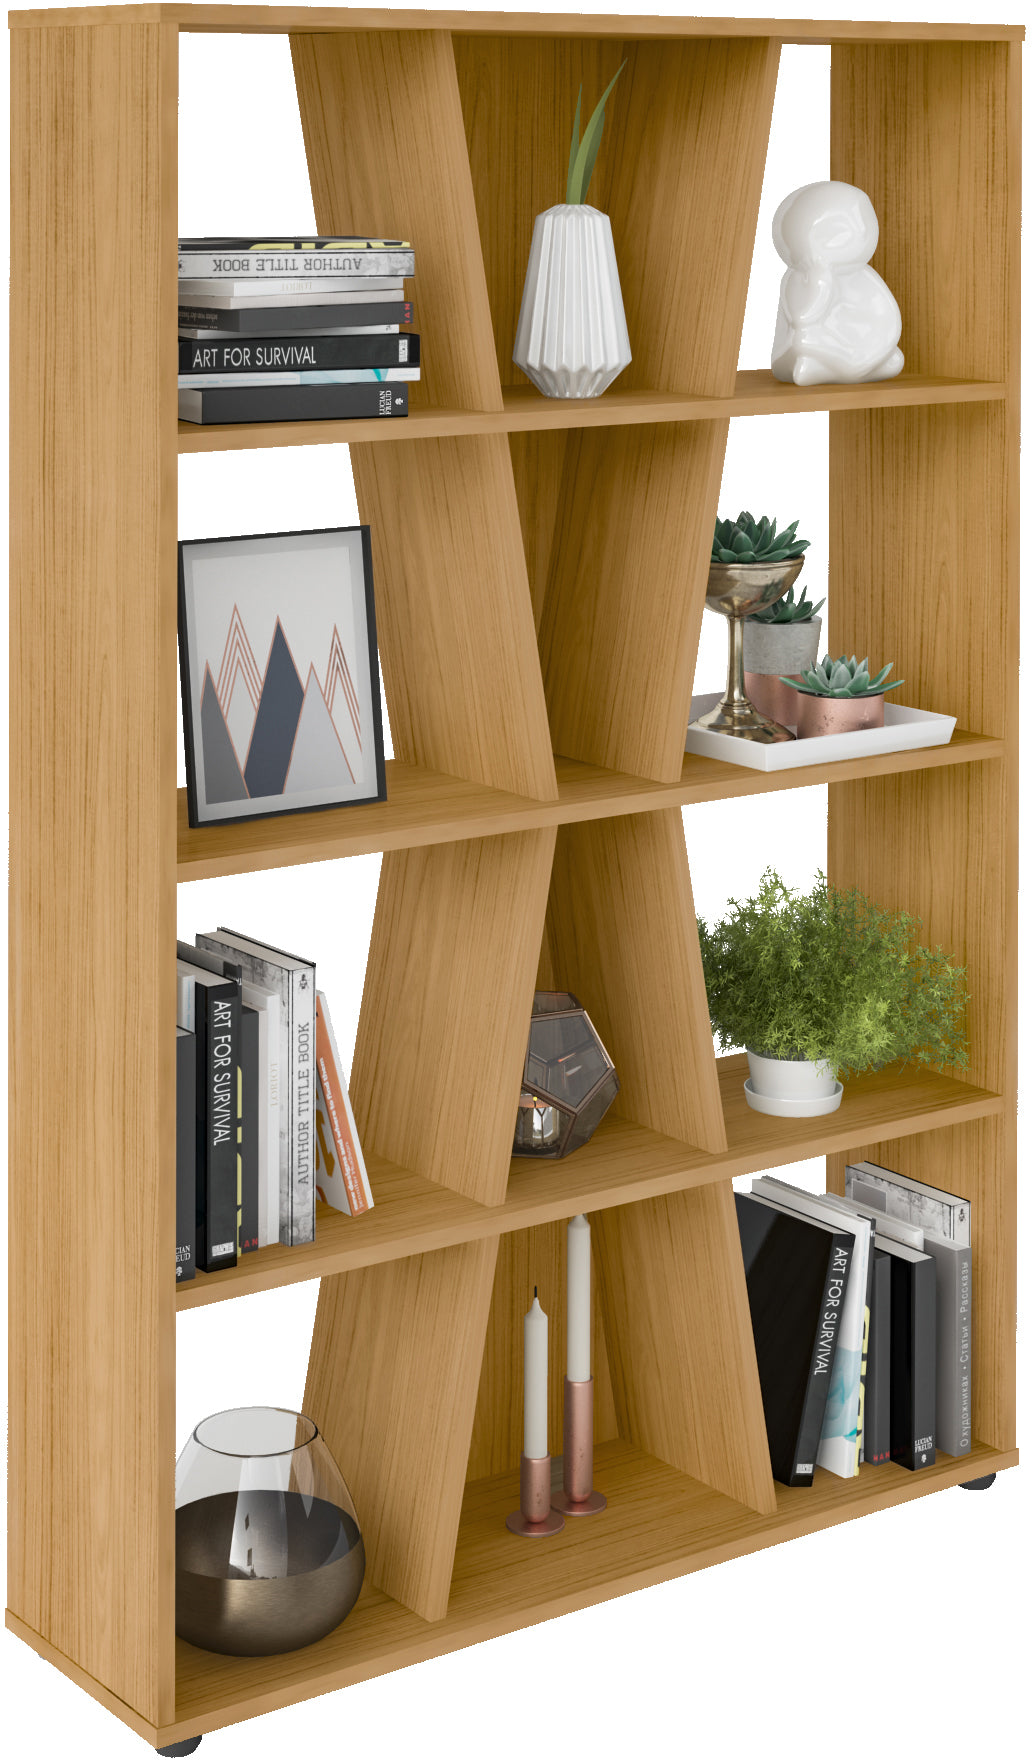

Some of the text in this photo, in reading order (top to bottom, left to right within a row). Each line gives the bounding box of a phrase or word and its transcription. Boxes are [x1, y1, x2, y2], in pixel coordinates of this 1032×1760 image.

[213, 257, 362, 272] AUTHOR TITLE BOOK
[192, 346, 316, 368] ART FOR SURVIVAL
[213, 1000, 231, 1146] ART FOR SURVIVAL
[324, 1081, 332, 1100] find
[297, 1021, 309, 1185] AUTHOR TITLE BOOK
[330, 1100, 335, 1110] to
[332, 1110, 341, 1138] where
[337, 1138, 346, 1156] and
[176, 1244, 191, 1255] CIAN
[241, 1237, 258, 1249] AN
[176, 1253, 191, 1262] EUD
[813, 1247, 848, 1375] ART FOR SURVIVAL
[960, 1262, 971, 1447] О художниках Статьи Рассказы
[914, 1435, 933, 1447] LUCIAN
[914, 1442, 933, 1453] FREUD
